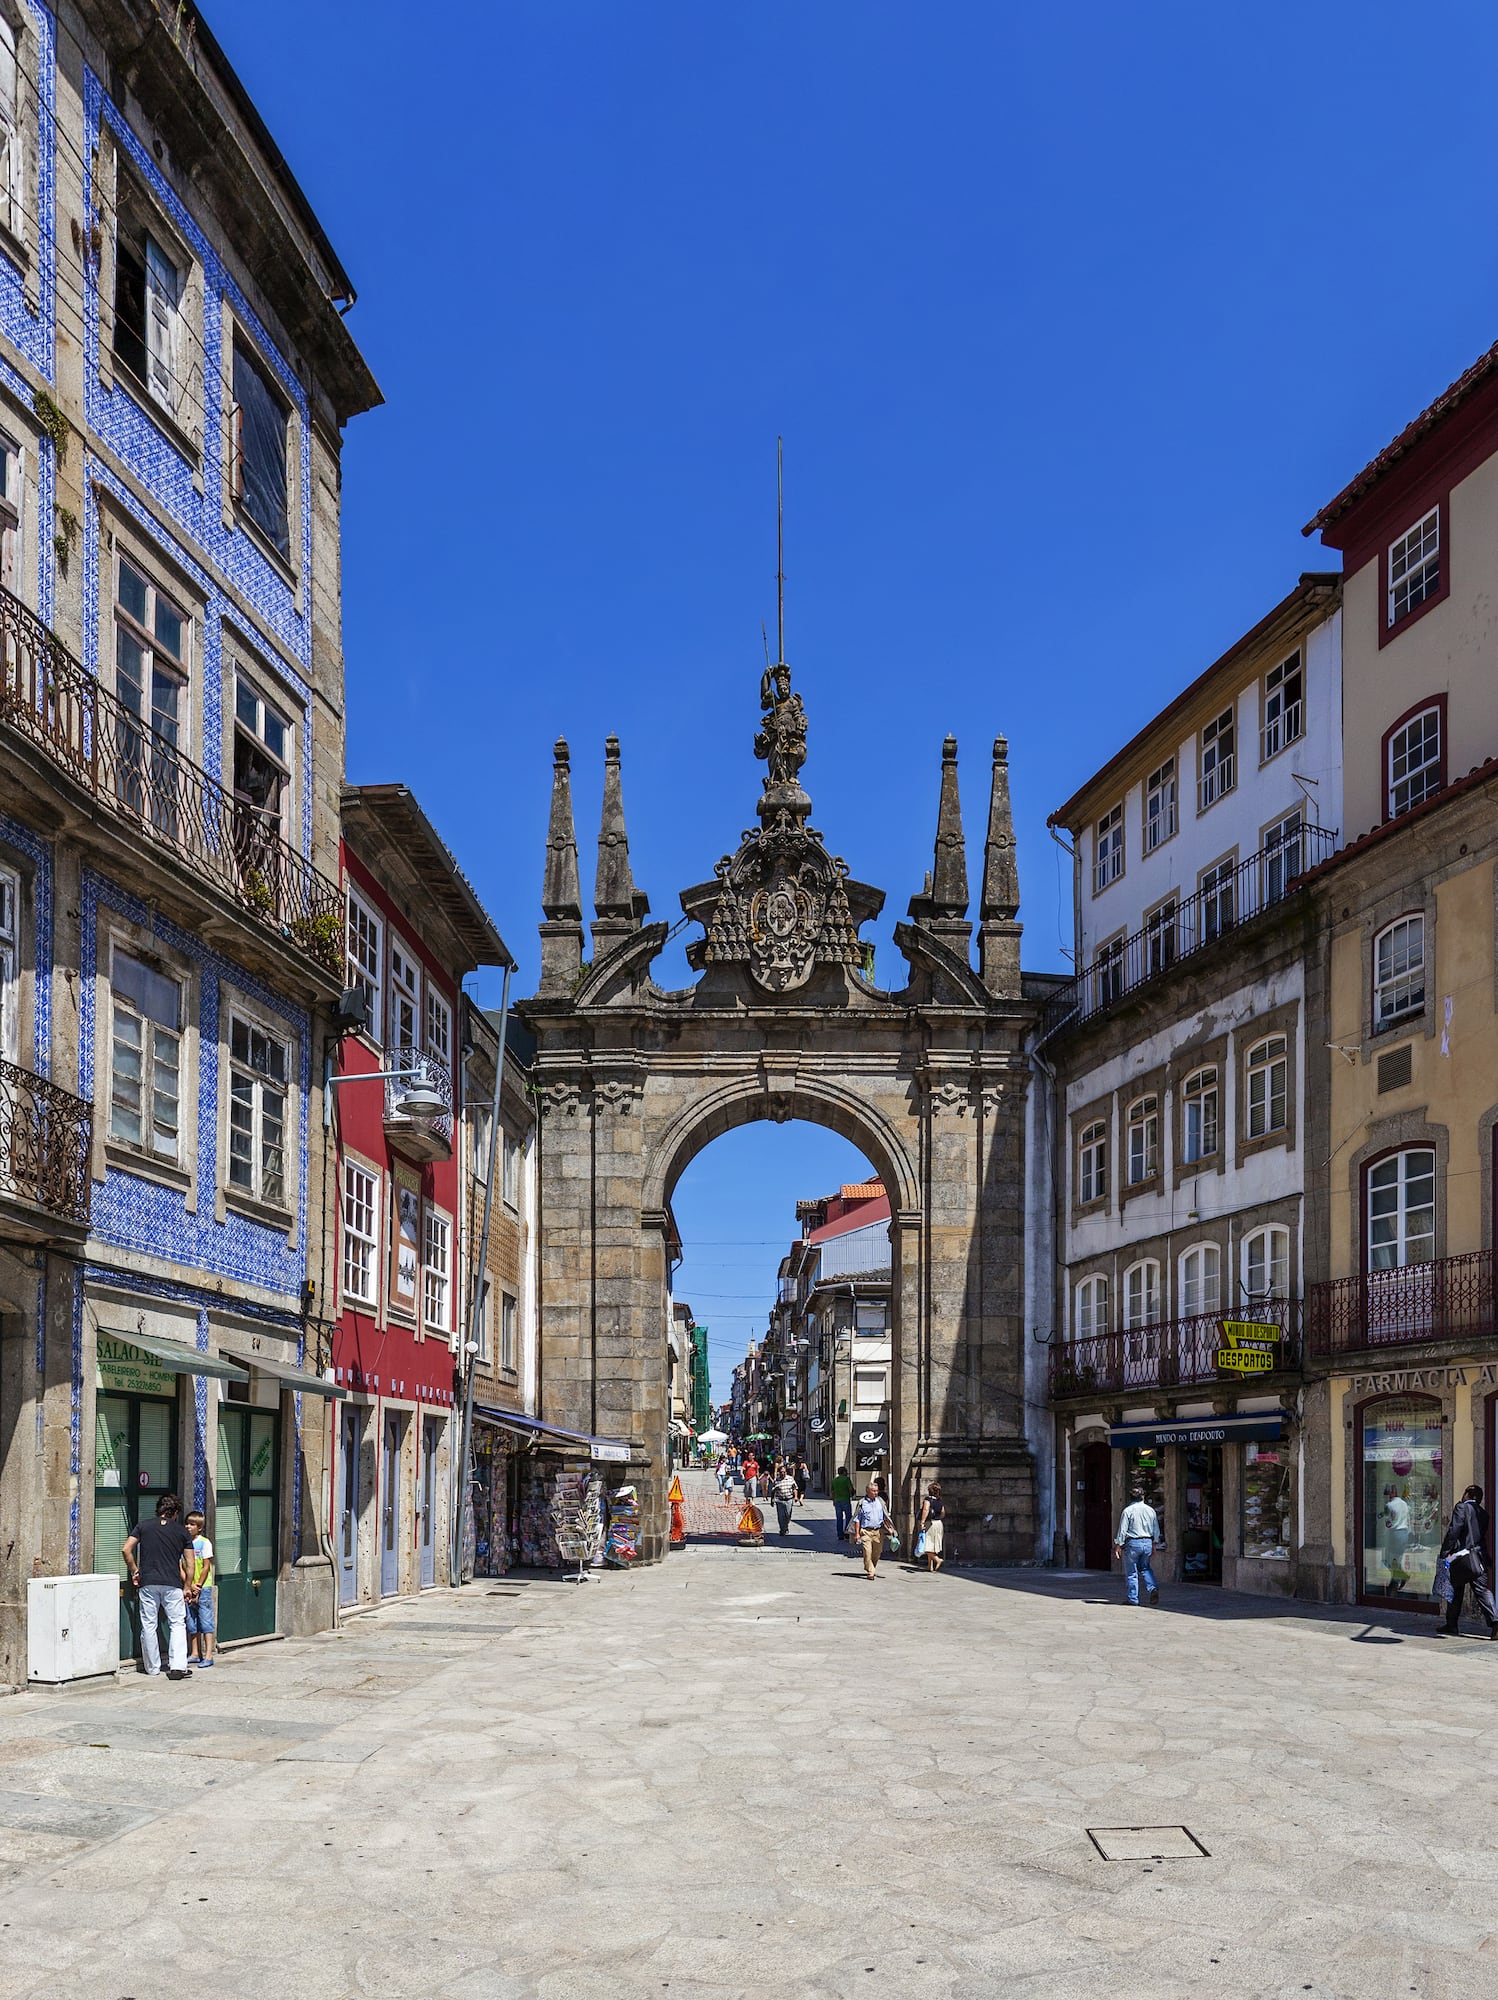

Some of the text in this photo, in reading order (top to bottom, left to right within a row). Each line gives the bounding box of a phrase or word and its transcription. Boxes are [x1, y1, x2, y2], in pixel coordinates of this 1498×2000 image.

[143, 1350, 162, 1367] SIL
[1220, 1351, 1272, 1369] DESPORTOS
[96, 1362, 141, 1378] CABELEIREIRO
[149, 1370, 177, 1383] HOMENS
[1385, 1420, 1406, 1432] NUK
[1155, 1429, 1225, 1444] MUNDO DO DESPORTO
